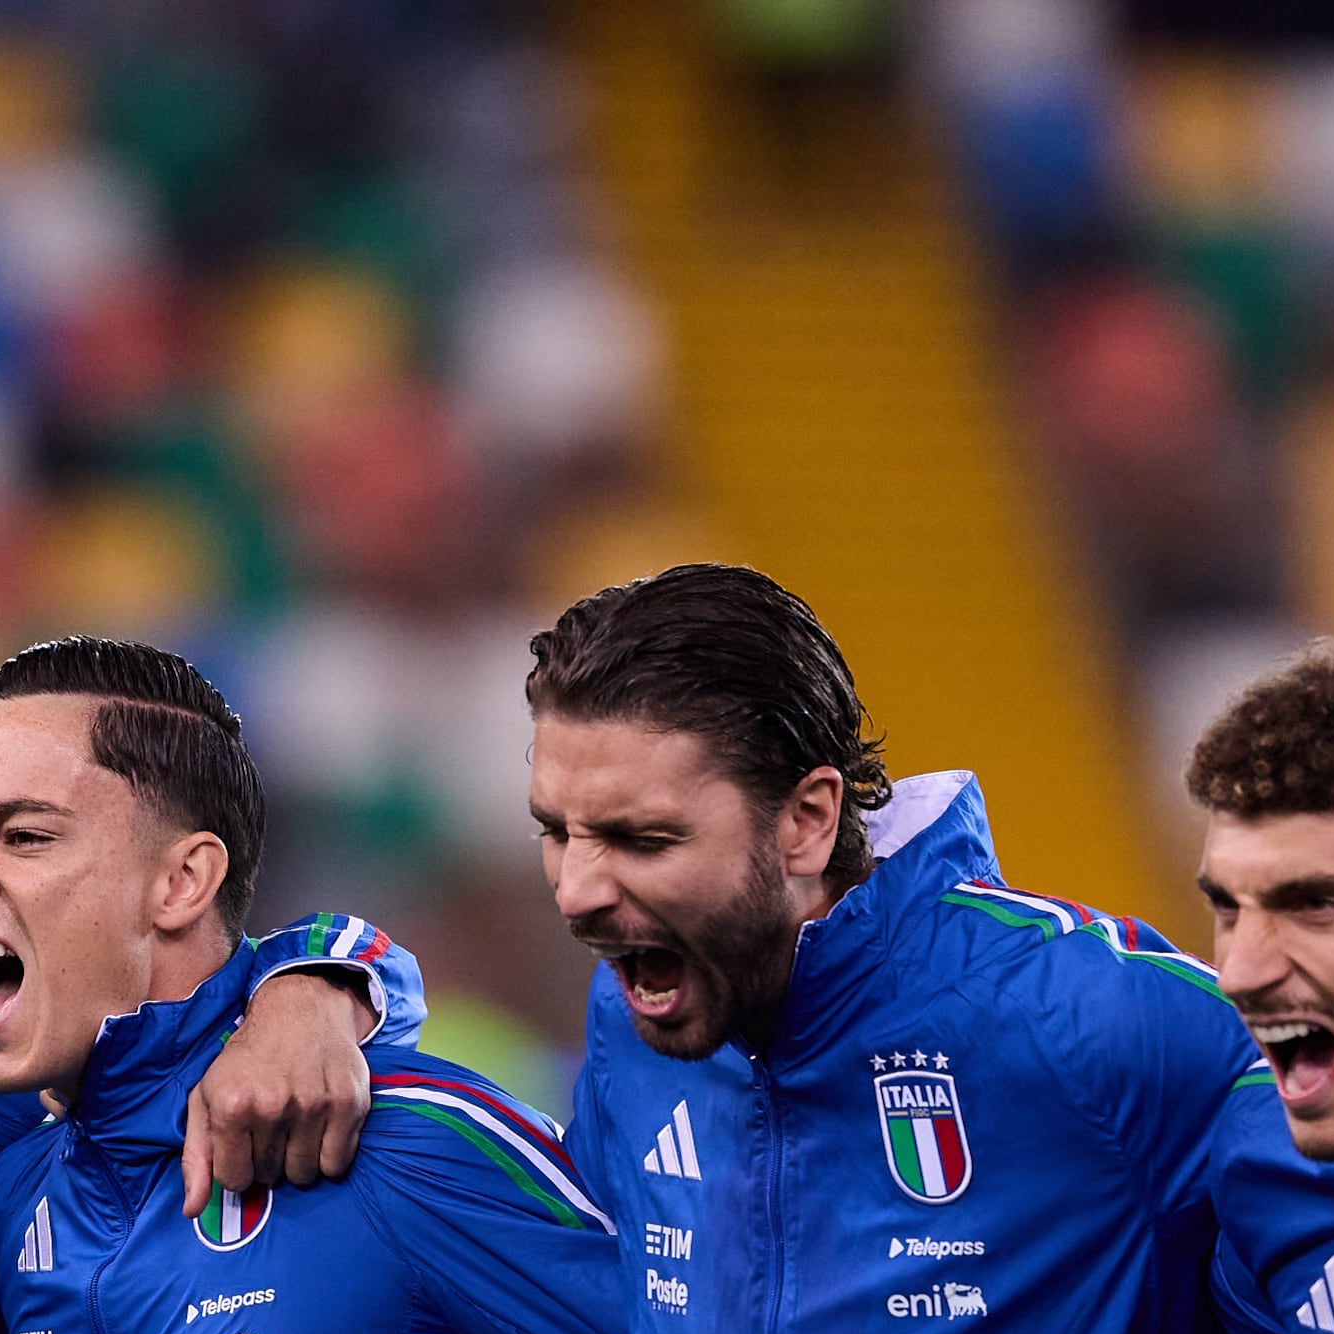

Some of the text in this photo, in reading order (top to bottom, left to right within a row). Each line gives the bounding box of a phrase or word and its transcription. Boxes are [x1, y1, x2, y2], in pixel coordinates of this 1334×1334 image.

[881, 1085, 951, 1108] ITALIA
[662, 1226, 693, 1260] TIM
[905, 1237, 985, 1260] Telepass
[199, 1288, 276, 1317] Telepass
[646, 1268, 688, 1307] Poste
[887, 1284, 941, 1317] eni
